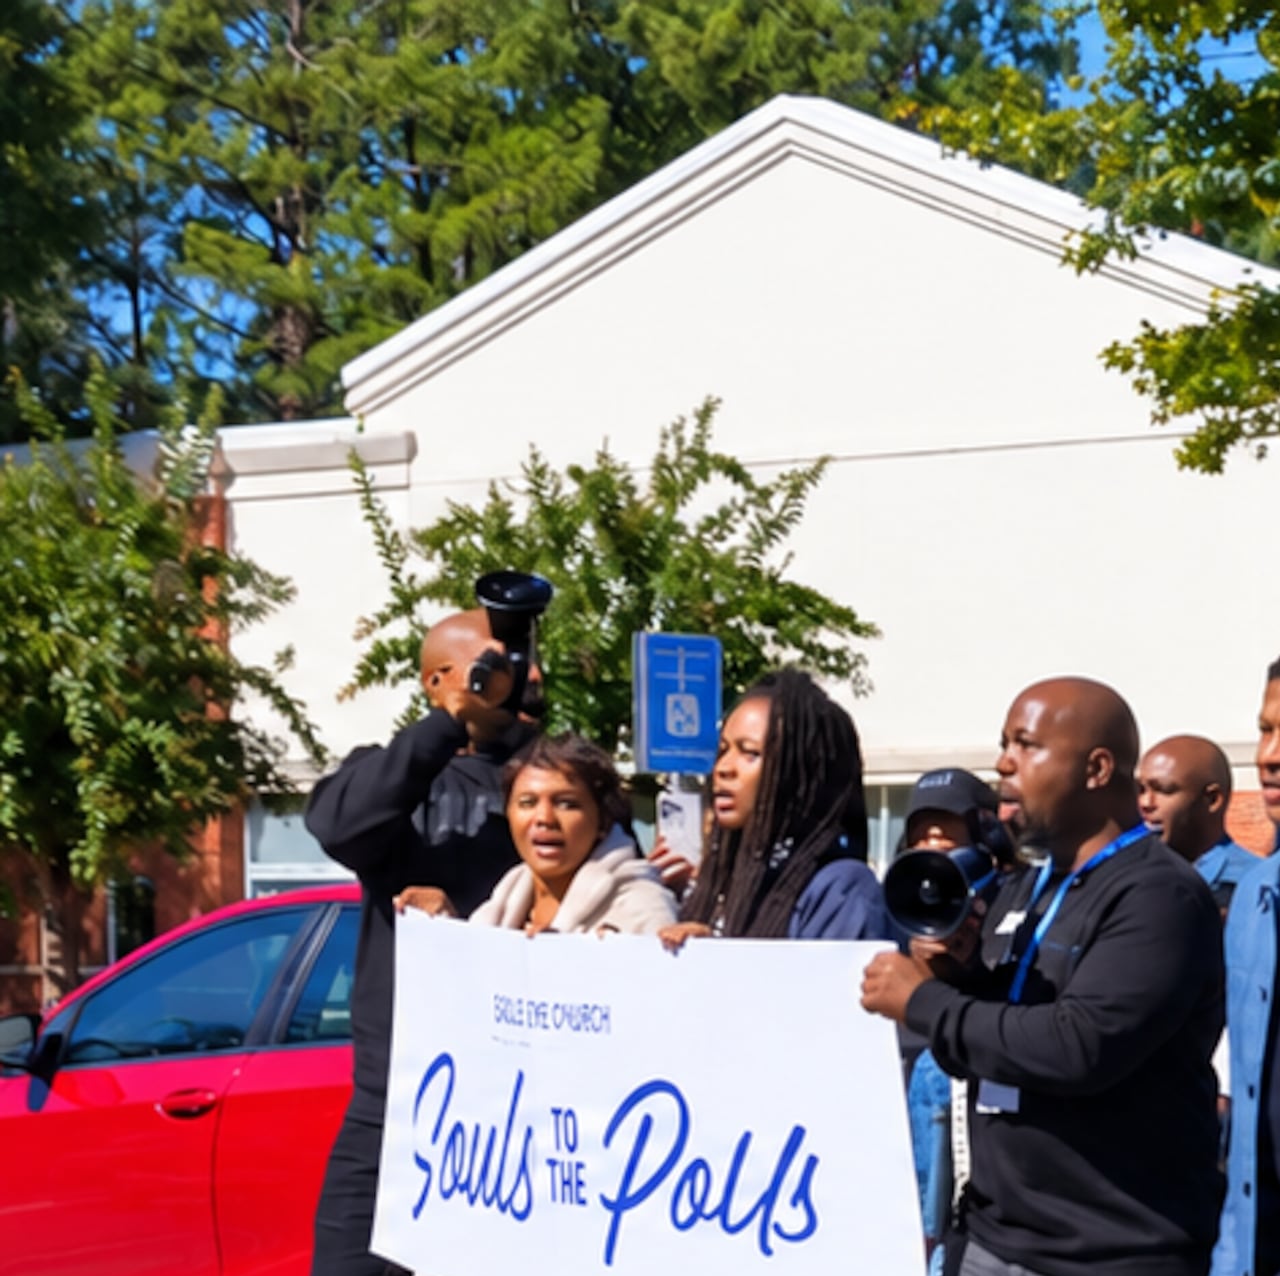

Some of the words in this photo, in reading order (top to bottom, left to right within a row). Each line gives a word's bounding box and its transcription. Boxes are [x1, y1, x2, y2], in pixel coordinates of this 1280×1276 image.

[413, 1052, 535, 1221] Souls
[546, 1158, 587, 1205] THE
[550, 1107, 579, 1153] TO
[600, 1079, 819, 1265] Polls
